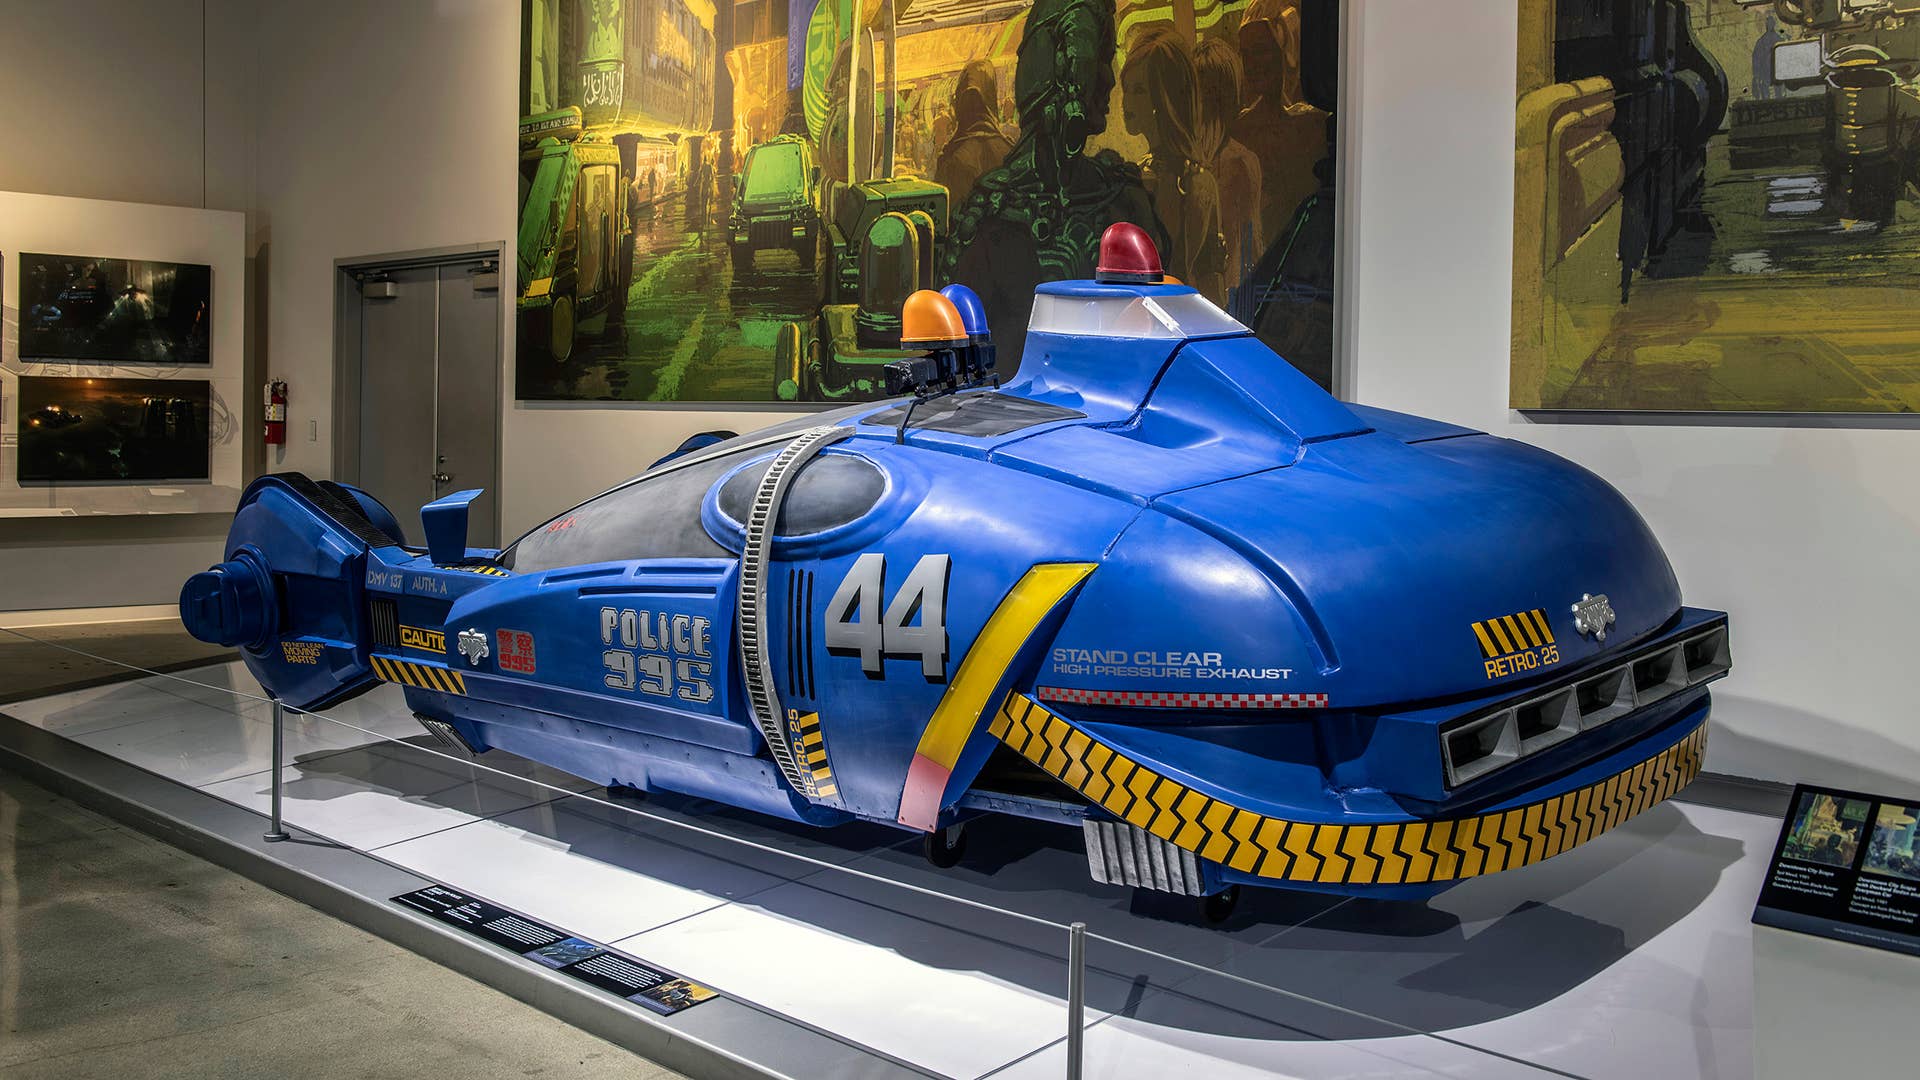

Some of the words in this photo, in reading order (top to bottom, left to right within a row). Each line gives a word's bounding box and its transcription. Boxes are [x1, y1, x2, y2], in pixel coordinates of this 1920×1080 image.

[368, 570, 388, 586] DMV
[390, 574, 403, 589] 137
[412, 576, 437, 593] AUTH.
[440, 581, 448, 595] A
[825, 553, 952, 683] 44
[601, 606, 711, 658] POLICE
[283, 647, 320, 657] MOVING
[286, 654, 317, 665] PARTS
[500, 653, 535, 673] 995
[1053, 648, 1128, 665] STAND
[1134, 651, 1222, 667] CLEAR
[1484, 651, 1541, 680] RETRO:
[1543, 645, 1560, 666] 25
[603, 648, 714, 704] 995
[1053, 663, 1090, 676] HIGH
[1094, 664, 1191, 679] PRESSURE
[1196, 668, 1293, 680] EXHAUST
[788, 708, 801, 733] 25
[794, 737, 819, 797] RETRO:
